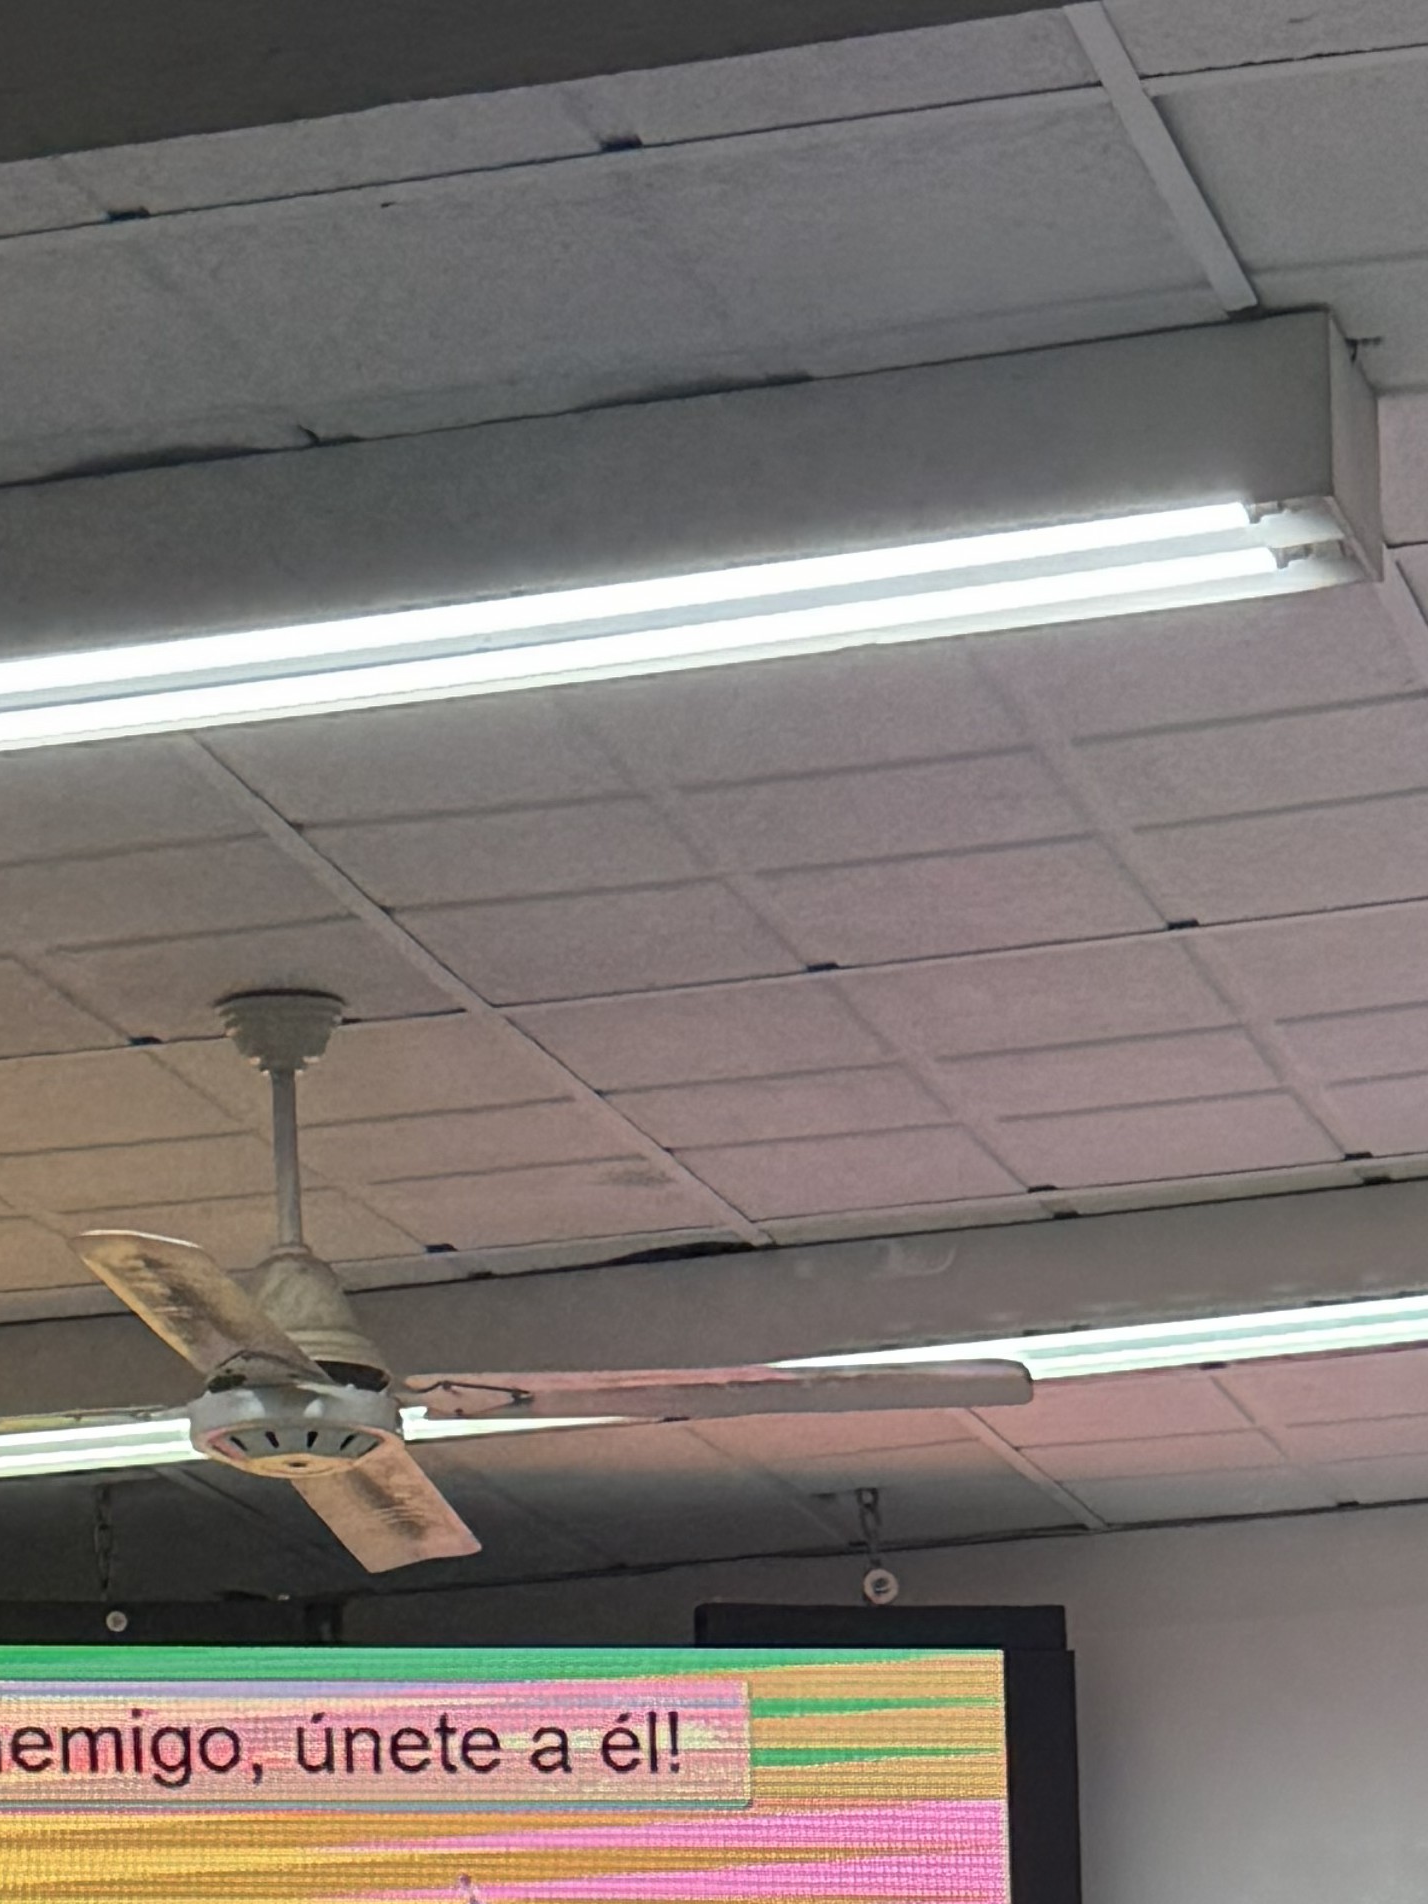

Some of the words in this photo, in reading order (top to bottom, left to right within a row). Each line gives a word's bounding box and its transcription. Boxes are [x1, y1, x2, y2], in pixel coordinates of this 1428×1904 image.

[296, 1711, 500, 1774] únete
[531, 1723, 573, 1774] a
[600, 1711, 681, 1774] él!
